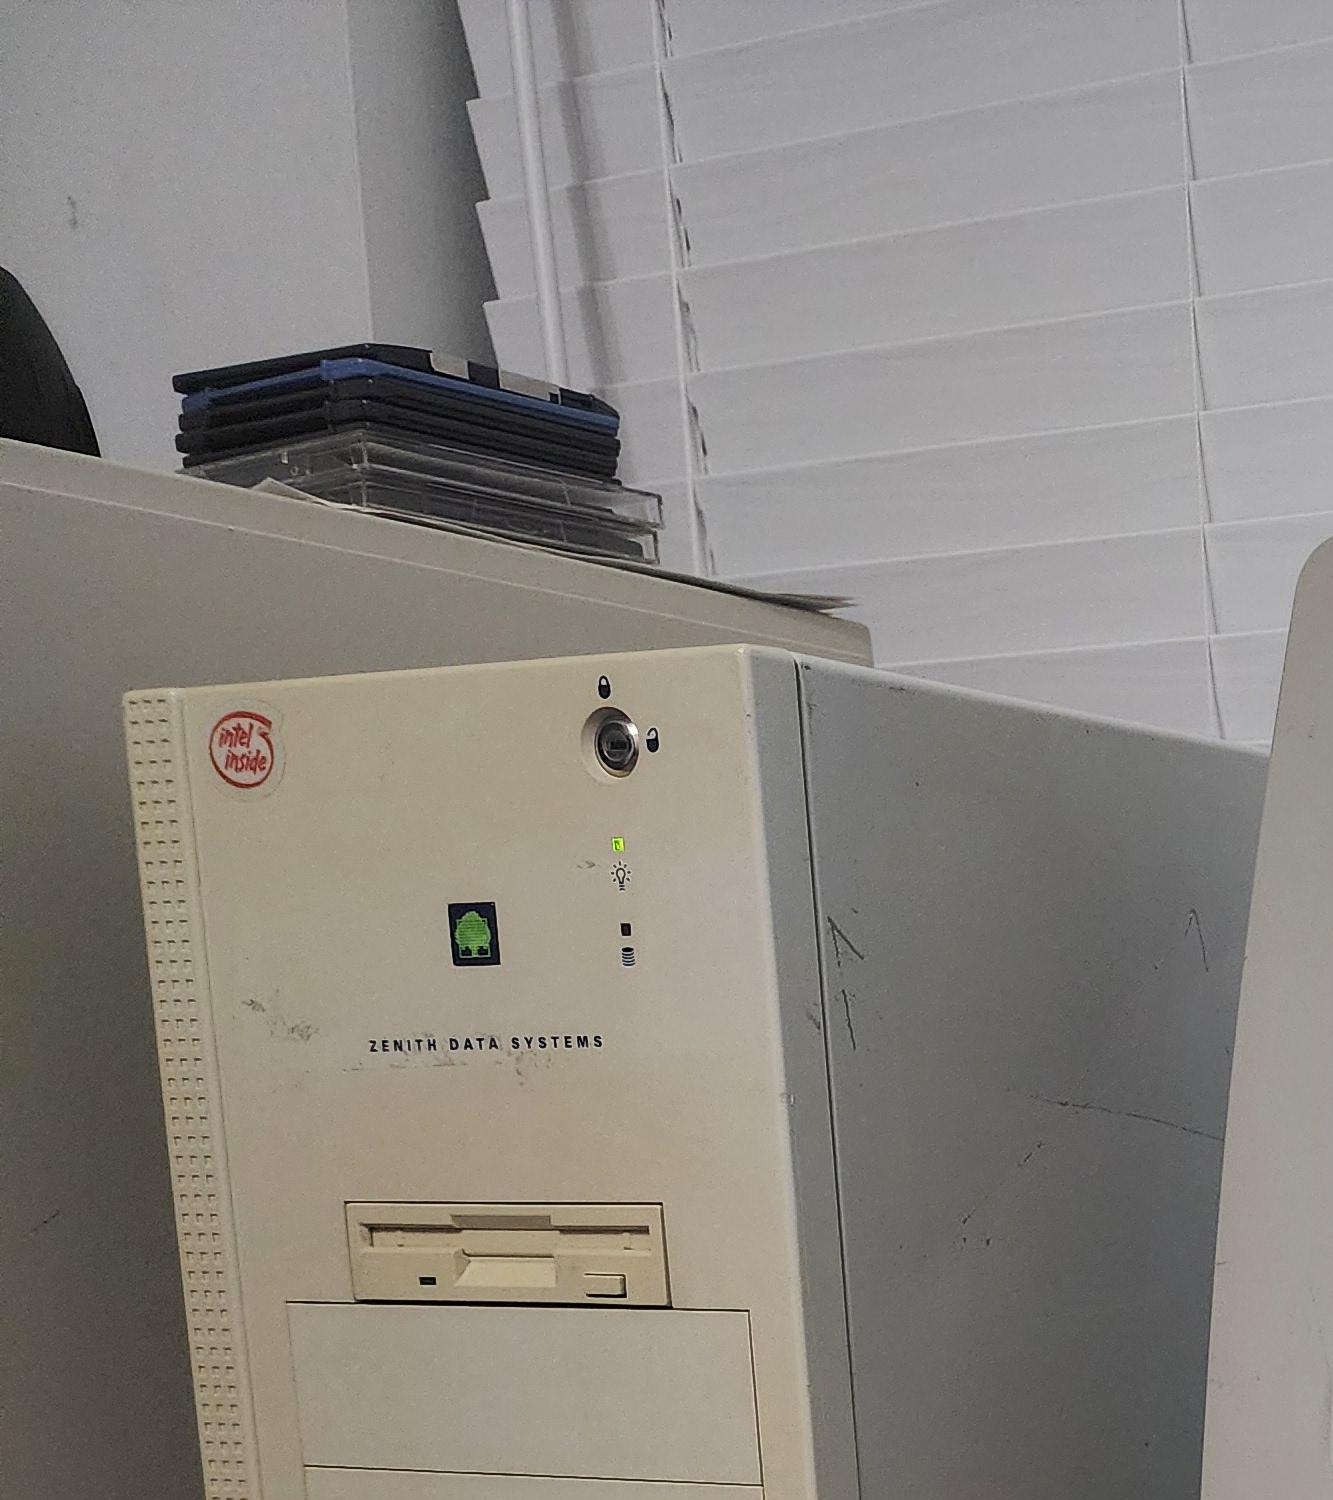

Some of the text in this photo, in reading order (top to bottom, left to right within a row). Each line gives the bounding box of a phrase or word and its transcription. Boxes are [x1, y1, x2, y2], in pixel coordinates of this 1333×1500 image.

[218, 721, 255, 748] intel
[224, 748, 268, 774] inside
[368, 1035, 603, 1053] ZENITH DATA SYSTEMS
